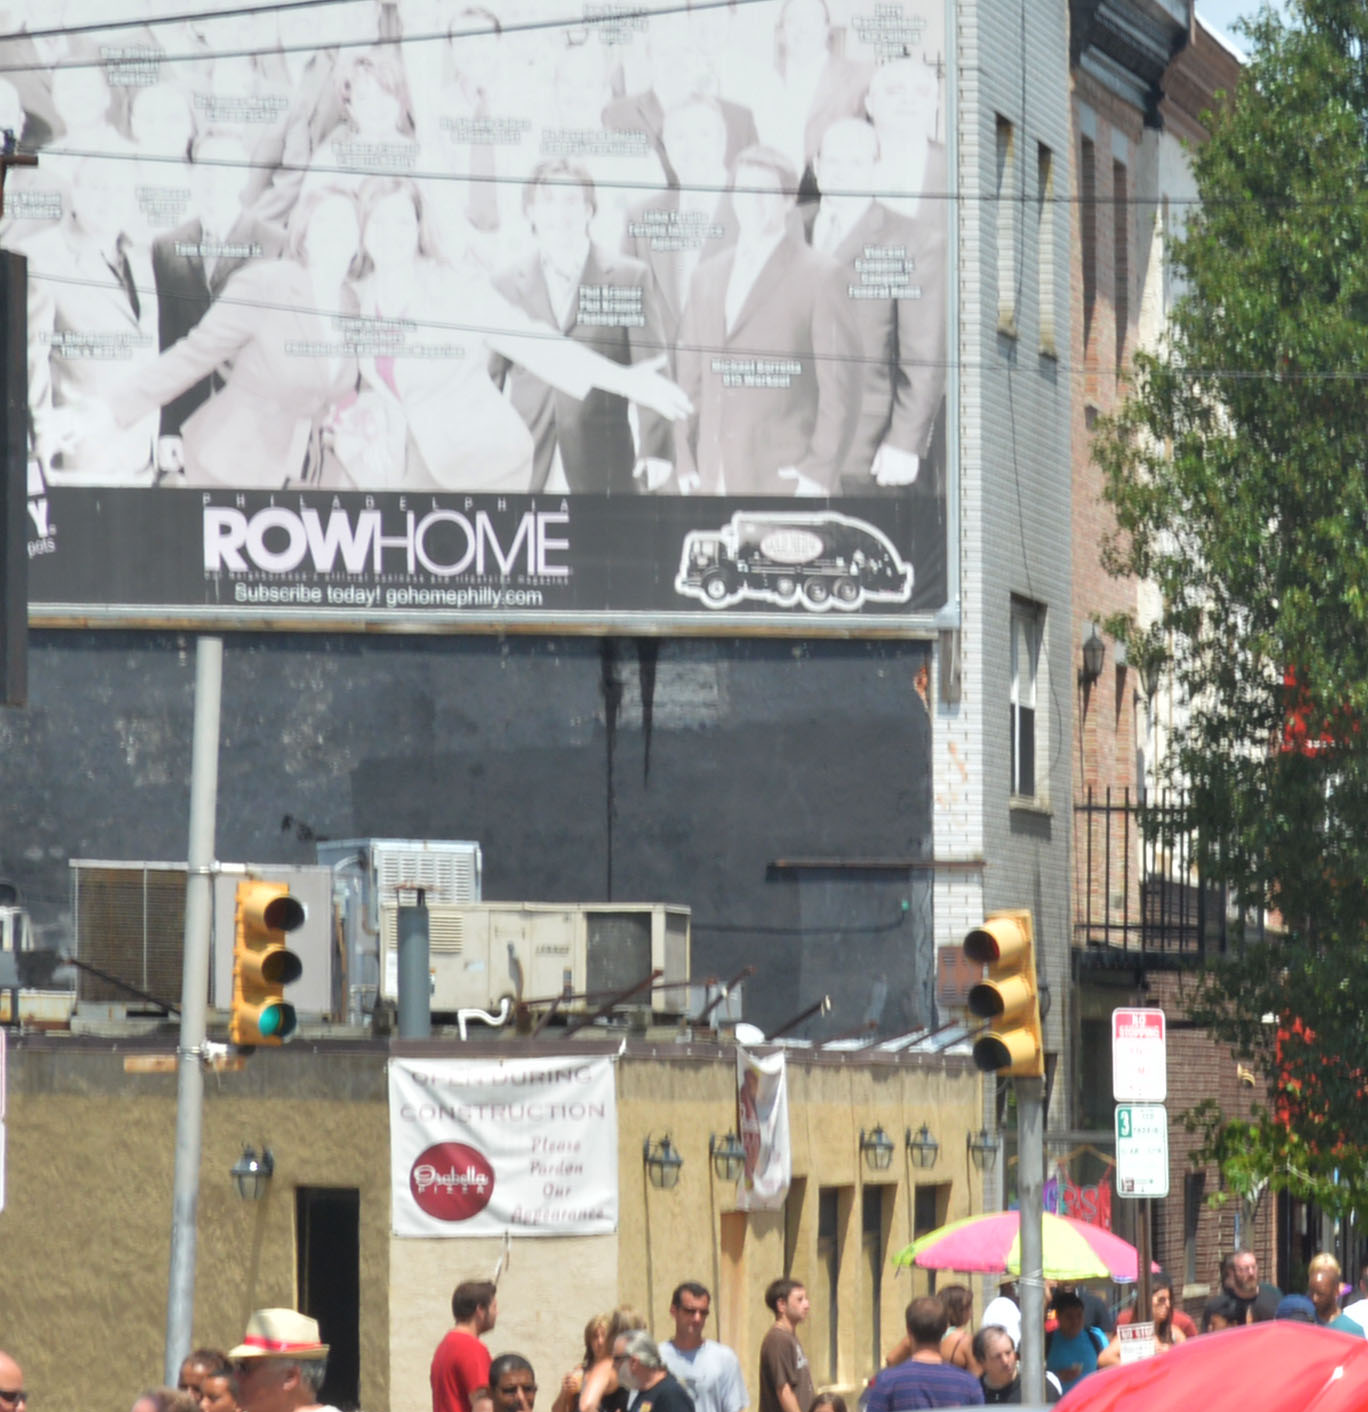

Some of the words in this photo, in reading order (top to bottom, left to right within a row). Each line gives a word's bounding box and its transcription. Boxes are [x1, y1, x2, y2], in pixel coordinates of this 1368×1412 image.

[203, 493, 569, 514] PHILADELPHIA
[235, 582, 322, 602] Subscribe
[327, 584, 380, 607] today!
[386, 585, 543, 609] gohomephilly.com
[400, 1102, 606, 1122] CONSTRUCTION
[530, 1136, 582, 1153] Please
[530, 1160, 584, 1177] Pardon
[542, 1183, 573, 1199] Our
